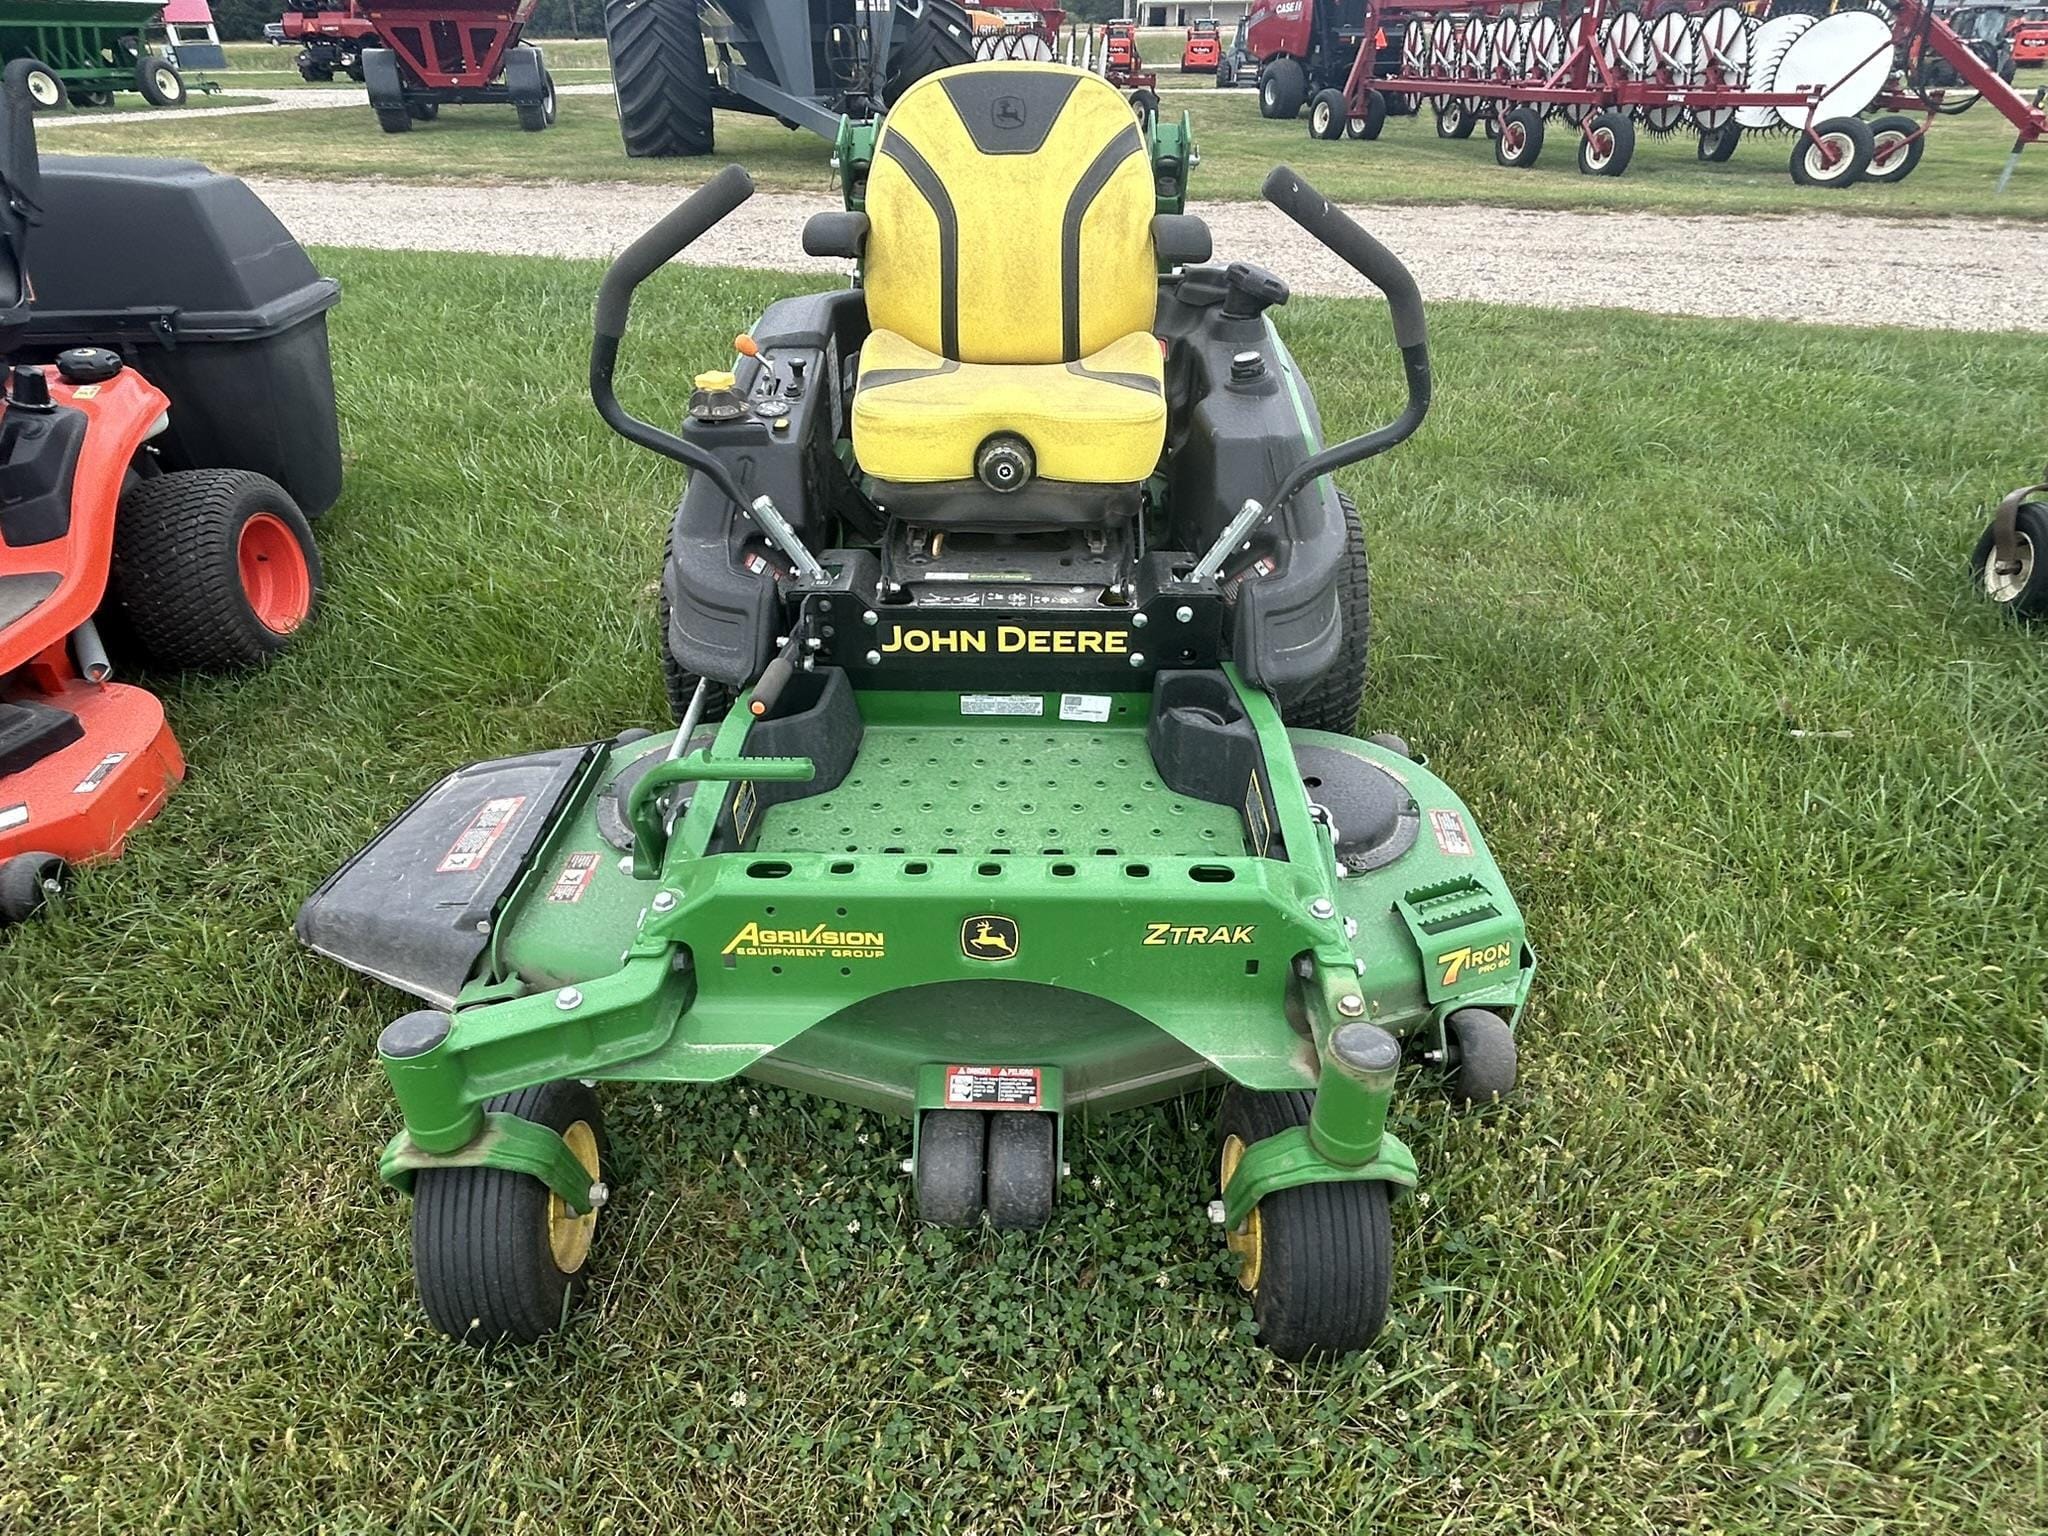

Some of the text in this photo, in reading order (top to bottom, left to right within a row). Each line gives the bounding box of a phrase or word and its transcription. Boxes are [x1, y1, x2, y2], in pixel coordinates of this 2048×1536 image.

[1276, 2, 1296, 14] CASE
[881, 625, 1129, 653] JOHN DEERE
[1143, 923, 1256, 945] ZTRAK
[736, 947, 885, 958] EQUIPMENT GROUP
[1478, 963, 1497, 975] PRO
